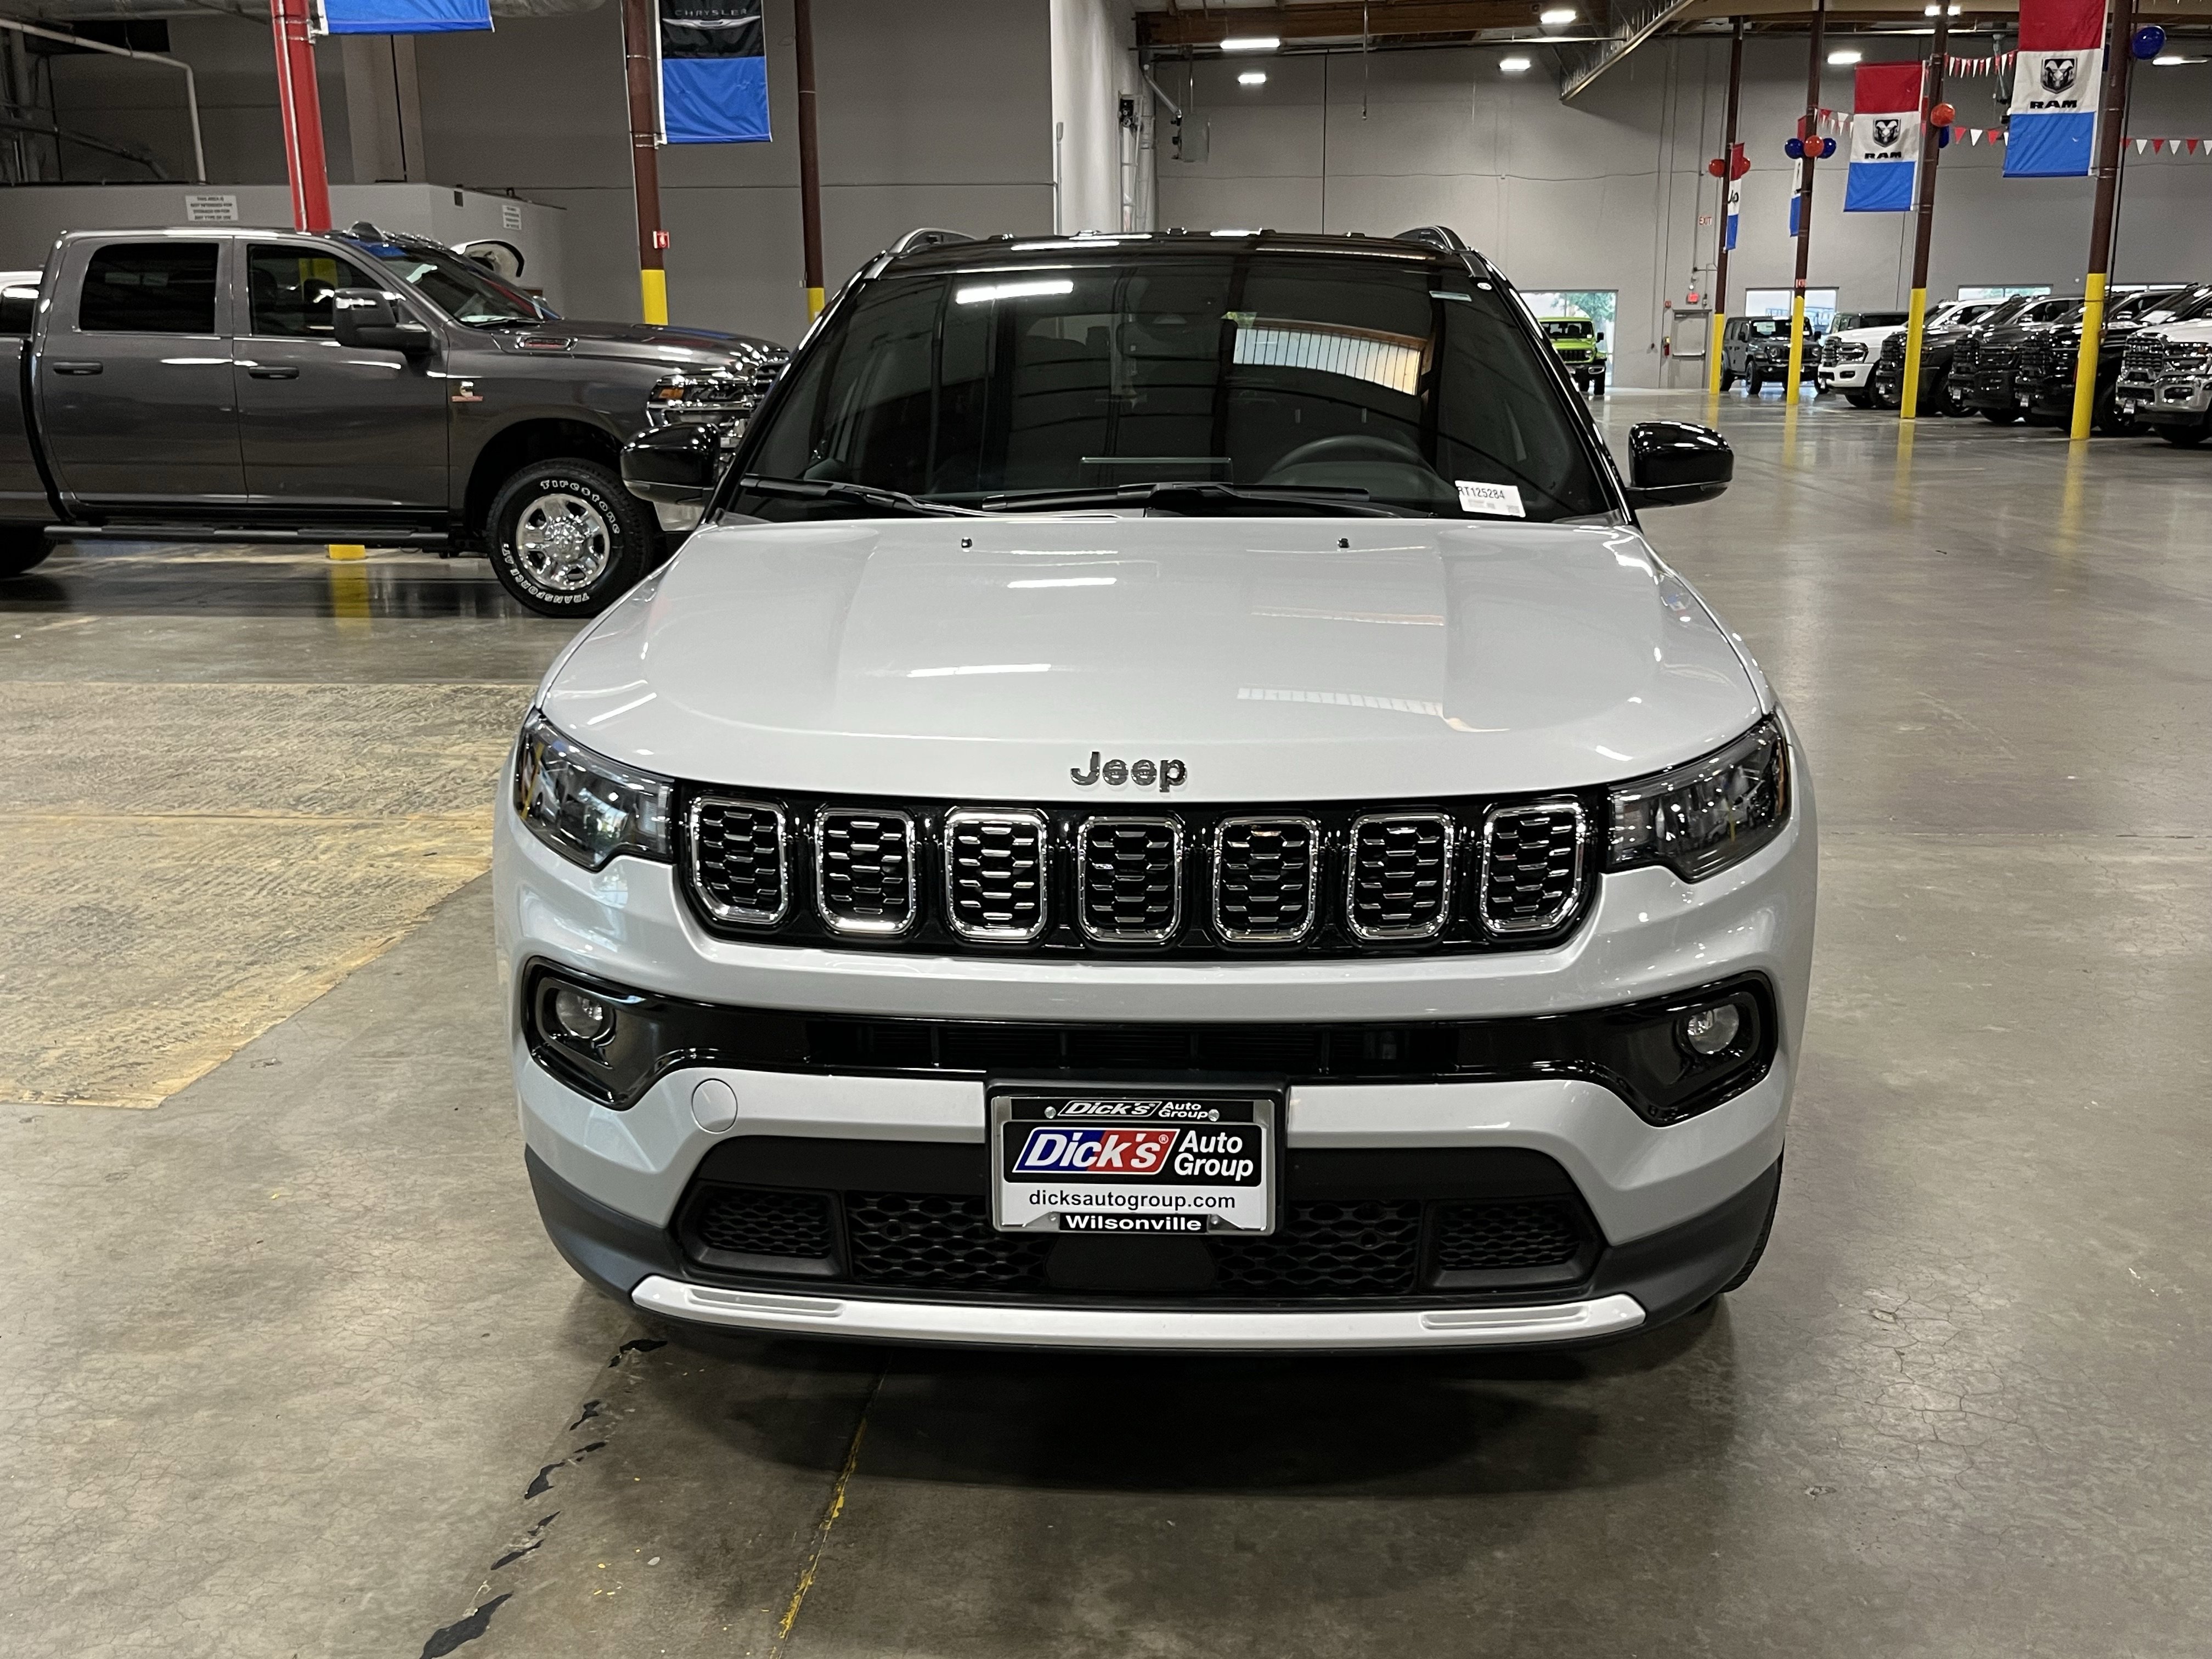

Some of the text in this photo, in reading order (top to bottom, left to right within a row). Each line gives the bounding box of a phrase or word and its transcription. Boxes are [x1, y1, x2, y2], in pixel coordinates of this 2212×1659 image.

[2030, 100, 2077, 109] RAM
[1699, 216, 1712, 225] EXIT
[1070, 751, 1188, 793] Jeep
[1065, 1102, 1201, 1115] Dick's Auto
[1158, 1109, 1207, 1120] Group
[1024, 1130, 1243, 1169] Dick's Auto
[1174, 1153, 1254, 1181] Group
[1029, 1190, 1235, 1211] dicksautogroup.com
[1065, 1215, 1201, 1231] Wilsonville
